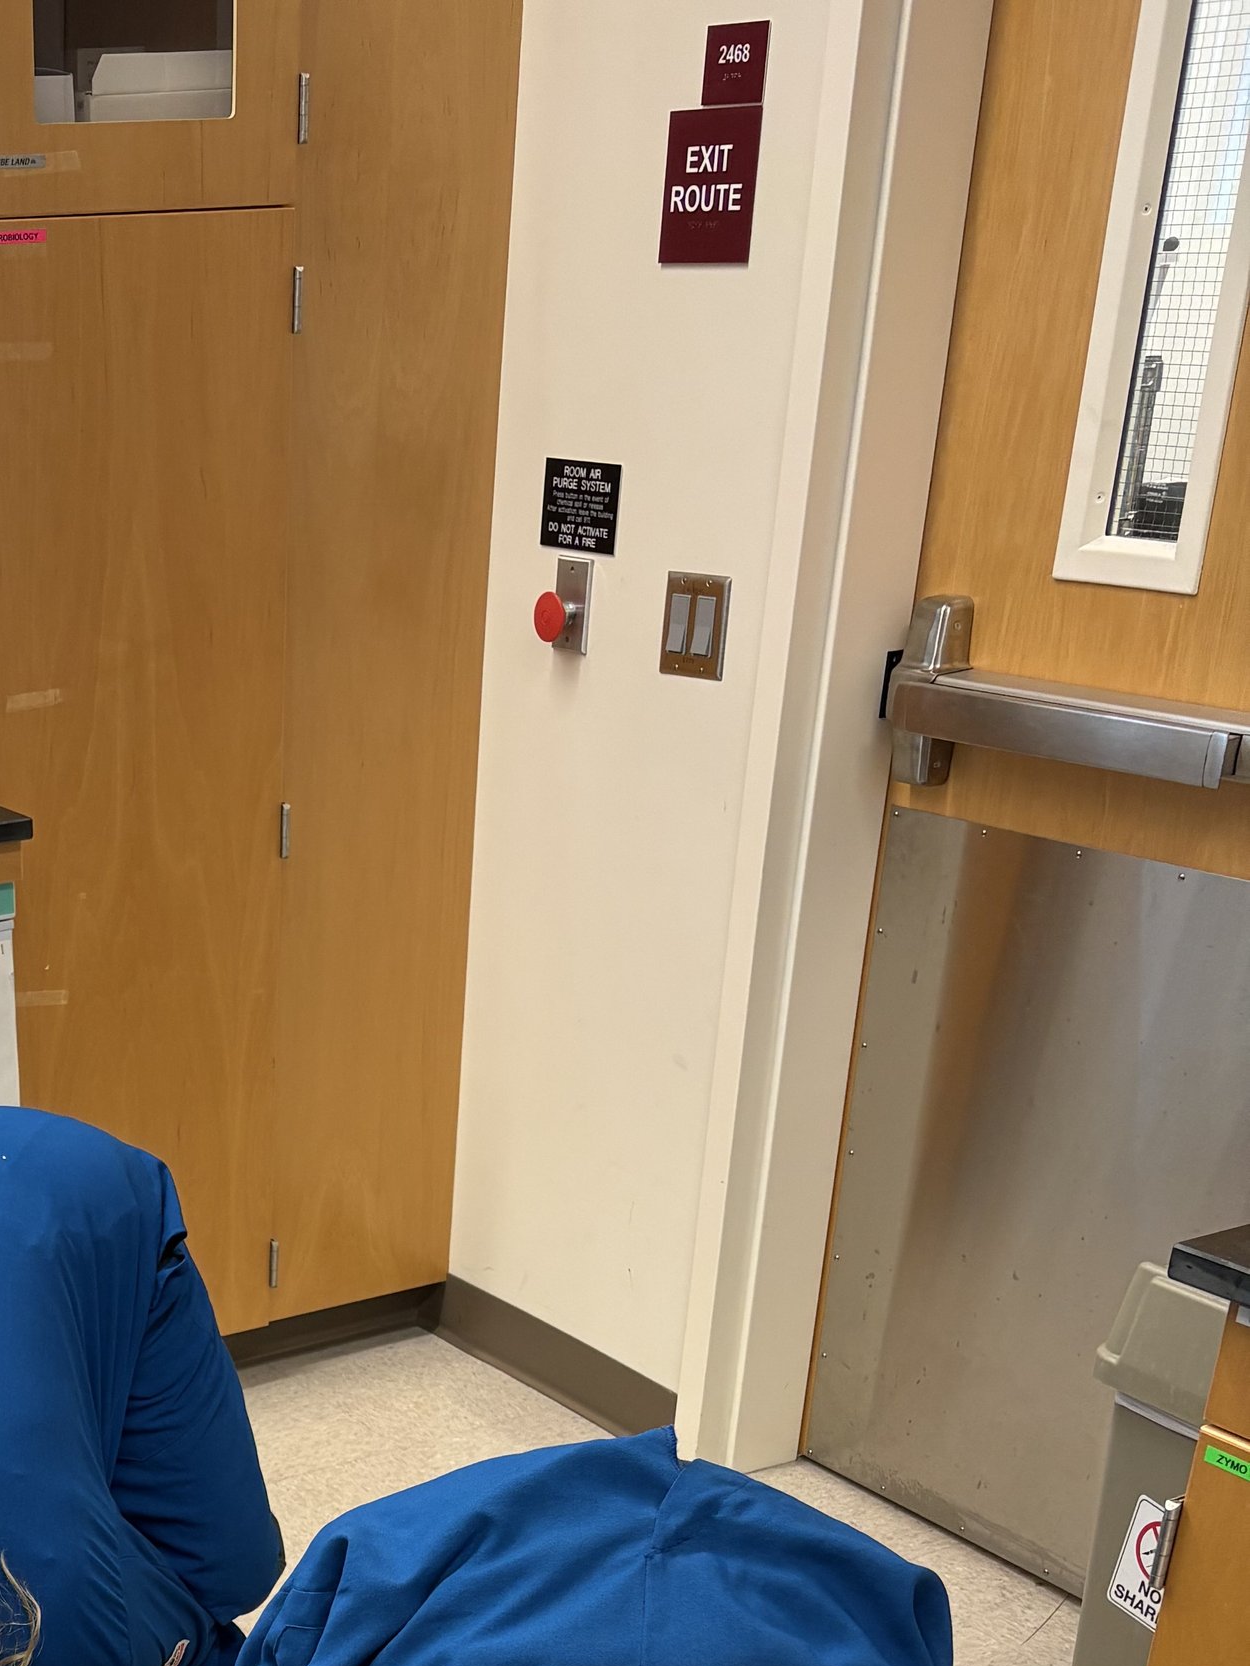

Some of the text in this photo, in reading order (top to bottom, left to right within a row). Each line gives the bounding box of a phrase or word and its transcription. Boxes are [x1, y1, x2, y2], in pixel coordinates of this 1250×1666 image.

[718, 43, 750, 64] 2468
[11, 157, 30, 166] LAND
[686, 144, 733, 174] EXIT
[670, 183, 743, 213] ROUTE
[564, 465, 602, 480] ROOM AIR
[553, 476, 611, 493] PURGE SYSTEM
[548, 521, 609, 539] DO NOT ACTIVATE
[558, 534, 596, 548] FOR A FIRE
[1216, 1454, 1248, 1475] ZYMO
[1138, 1580, 1162, 1605] NO
[1114, 1583, 1159, 1625] SHAR
